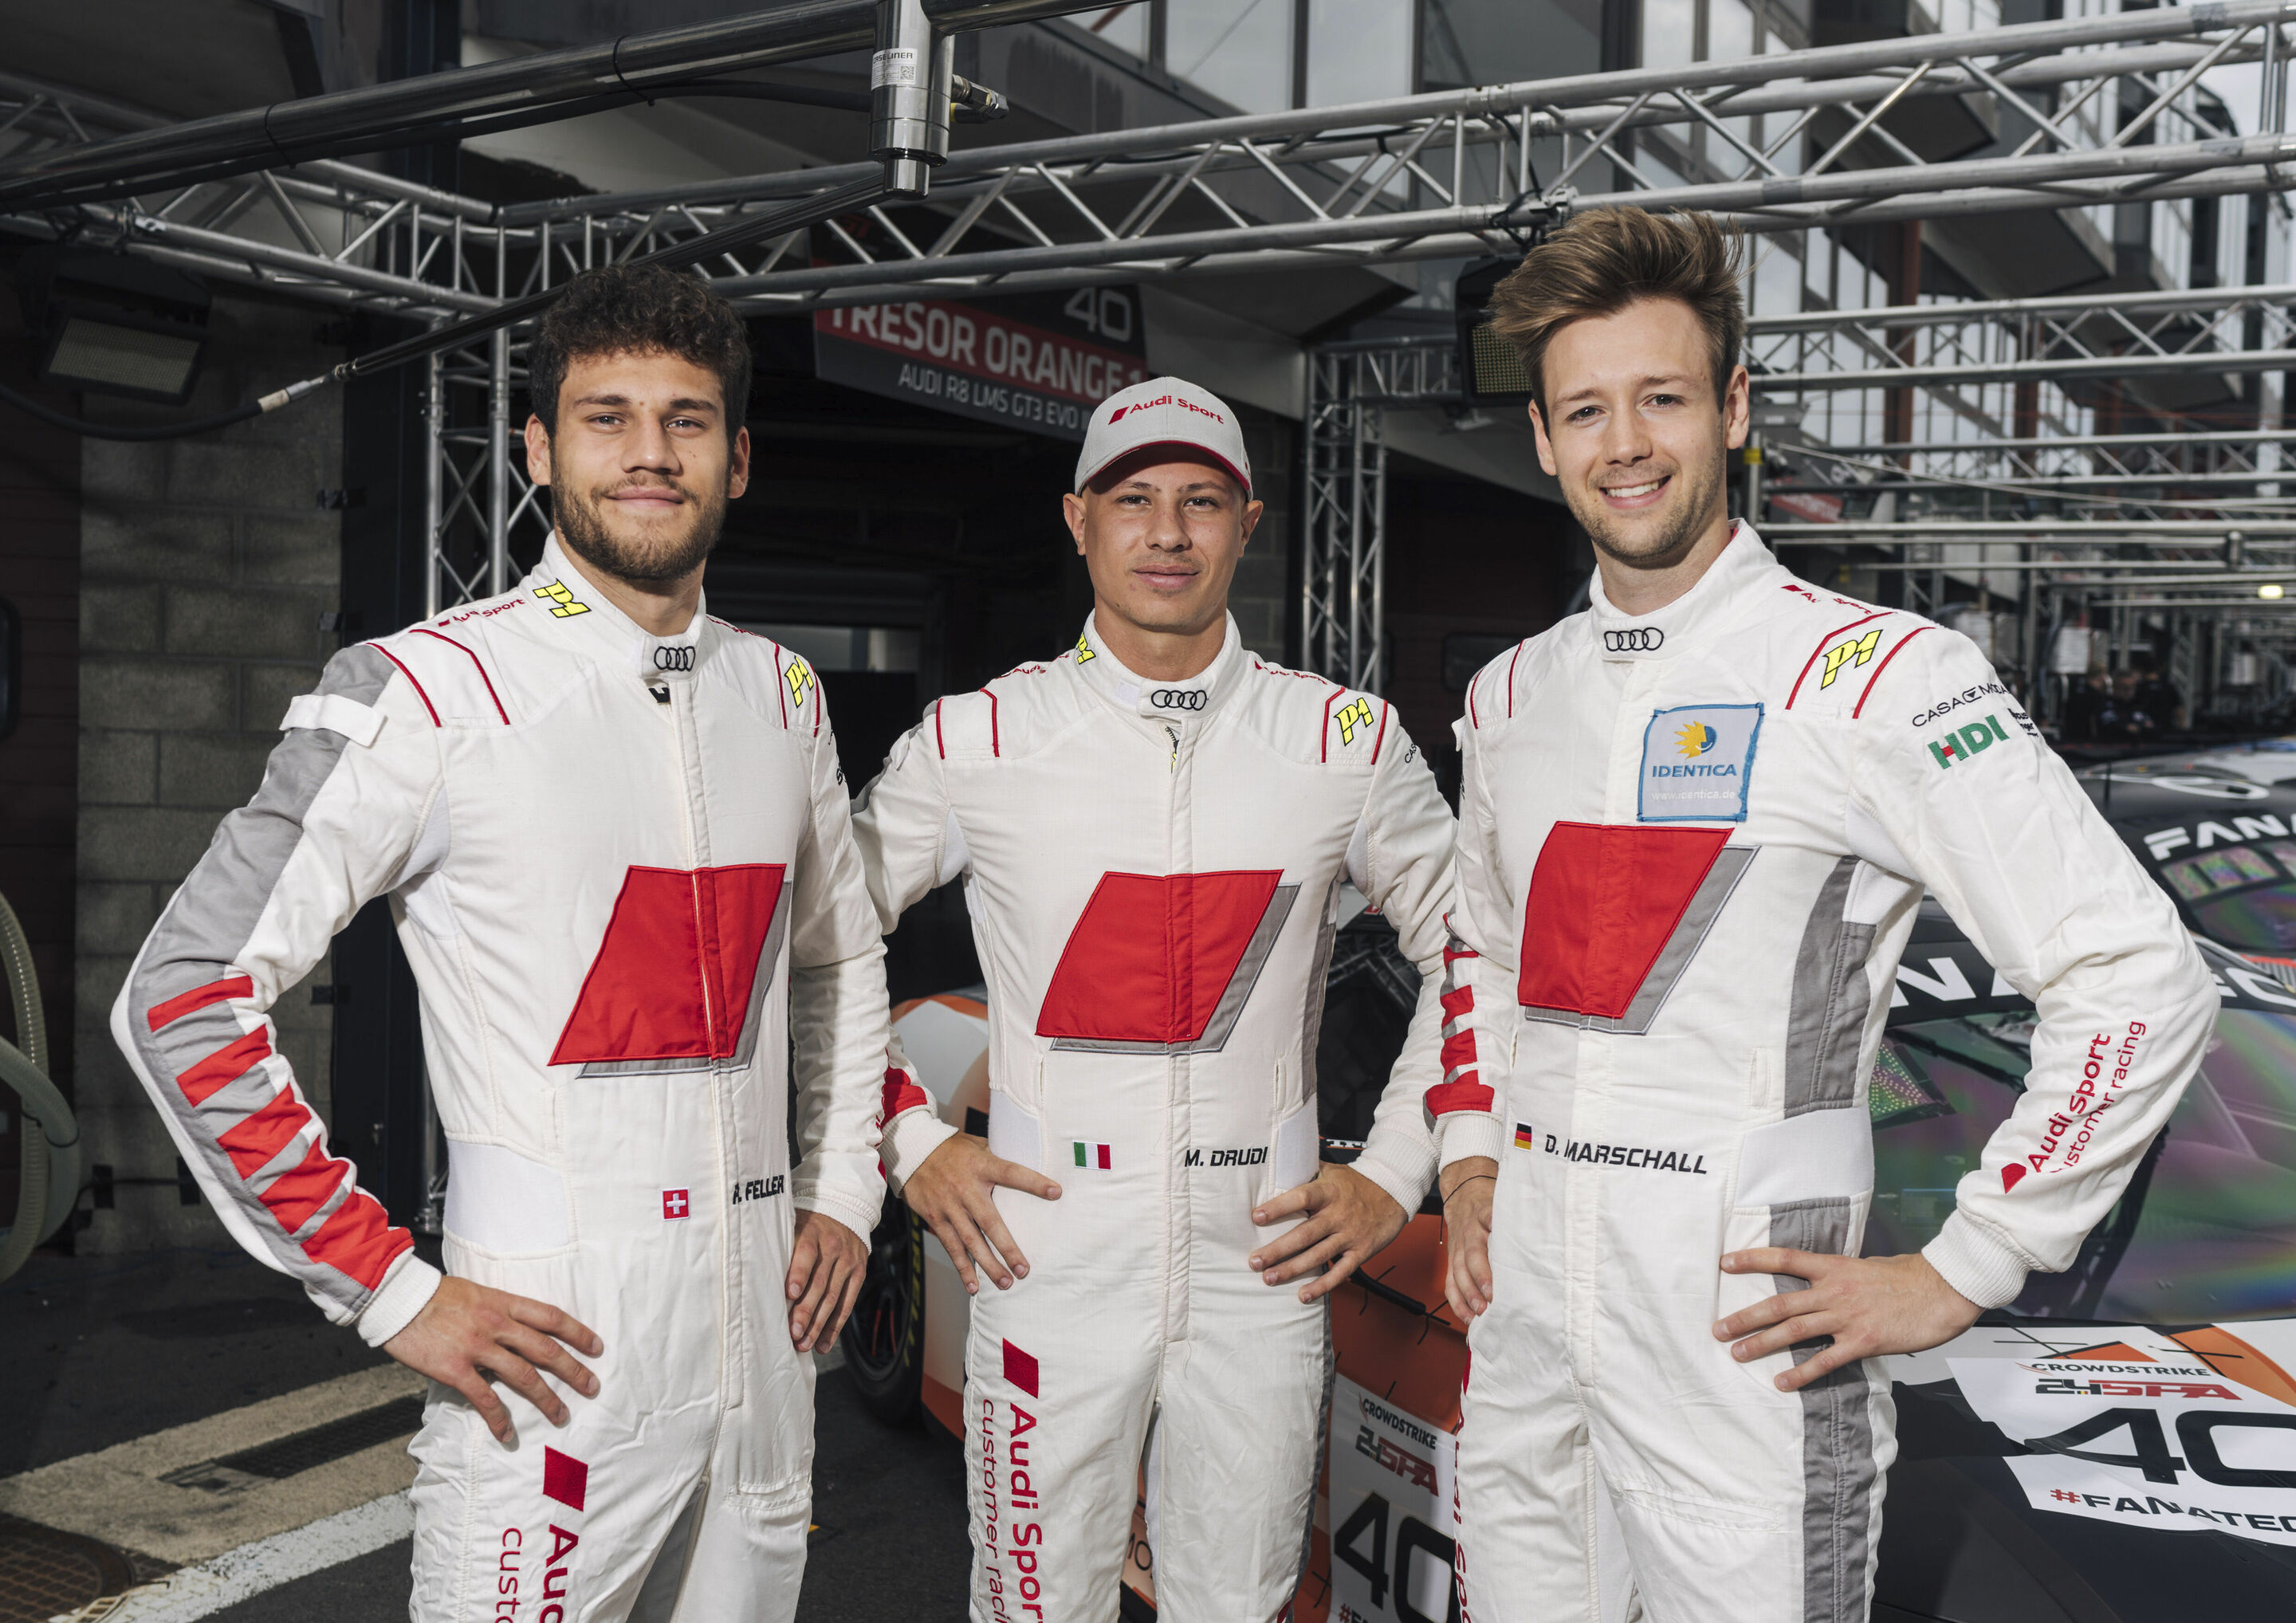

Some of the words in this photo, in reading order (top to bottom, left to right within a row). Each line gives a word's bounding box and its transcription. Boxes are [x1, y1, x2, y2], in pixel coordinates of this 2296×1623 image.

[1064, 287, 1130, 342] 40
[985, 326, 1123, 400] ORANGE
[898, 364, 942, 396] AUDI
[946, 375, 969, 403] R8
[972, 383, 1009, 414] LMS
[1011, 391, 1042, 424] GT3
[1045, 400, 1079, 430] EVO
[1130, 395, 1172, 415] Audi
[1177, 398, 1225, 425] Sport
[482, 599, 526, 617] Sport
[533, 577, 592, 619] P1
[784, 654, 815, 709] P1
[1820, 629, 1884, 690] P1
[1333, 697, 1374, 747] P1
[1927, 714, 2010, 770] HDI
[1652, 764, 1737, 777] IDENTICA
[2143, 814, 2296, 862] FAN
[2110, 1021, 2146, 1089] racing
[2027, 1112, 2074, 1173] Audi
[2069, 1033, 2111, 1115] Sport
[1185, 1149, 1204, 1167] M.
[1210, 1146, 1268, 1166] DRUDI
[1544, 1134, 1559, 1156] D.
[1563, 1138, 1708, 1175] MARSCHALL
[745, 1174, 784, 1201] FELLER
[2031, 1363, 2211, 1377] CROWDSTRIKE
[1362, 1398, 1437, 1451] CROWDSTRIKE
[2024, 1408, 2296, 1488] 40
[982, 1399, 998, 1559] customer
[1009, 1402, 1039, 1510] Audi
[494, 1528, 522, 1623] cust
[985, 1566, 1012, 1623] raci
[1008, 1523, 1044, 1623] Spor
